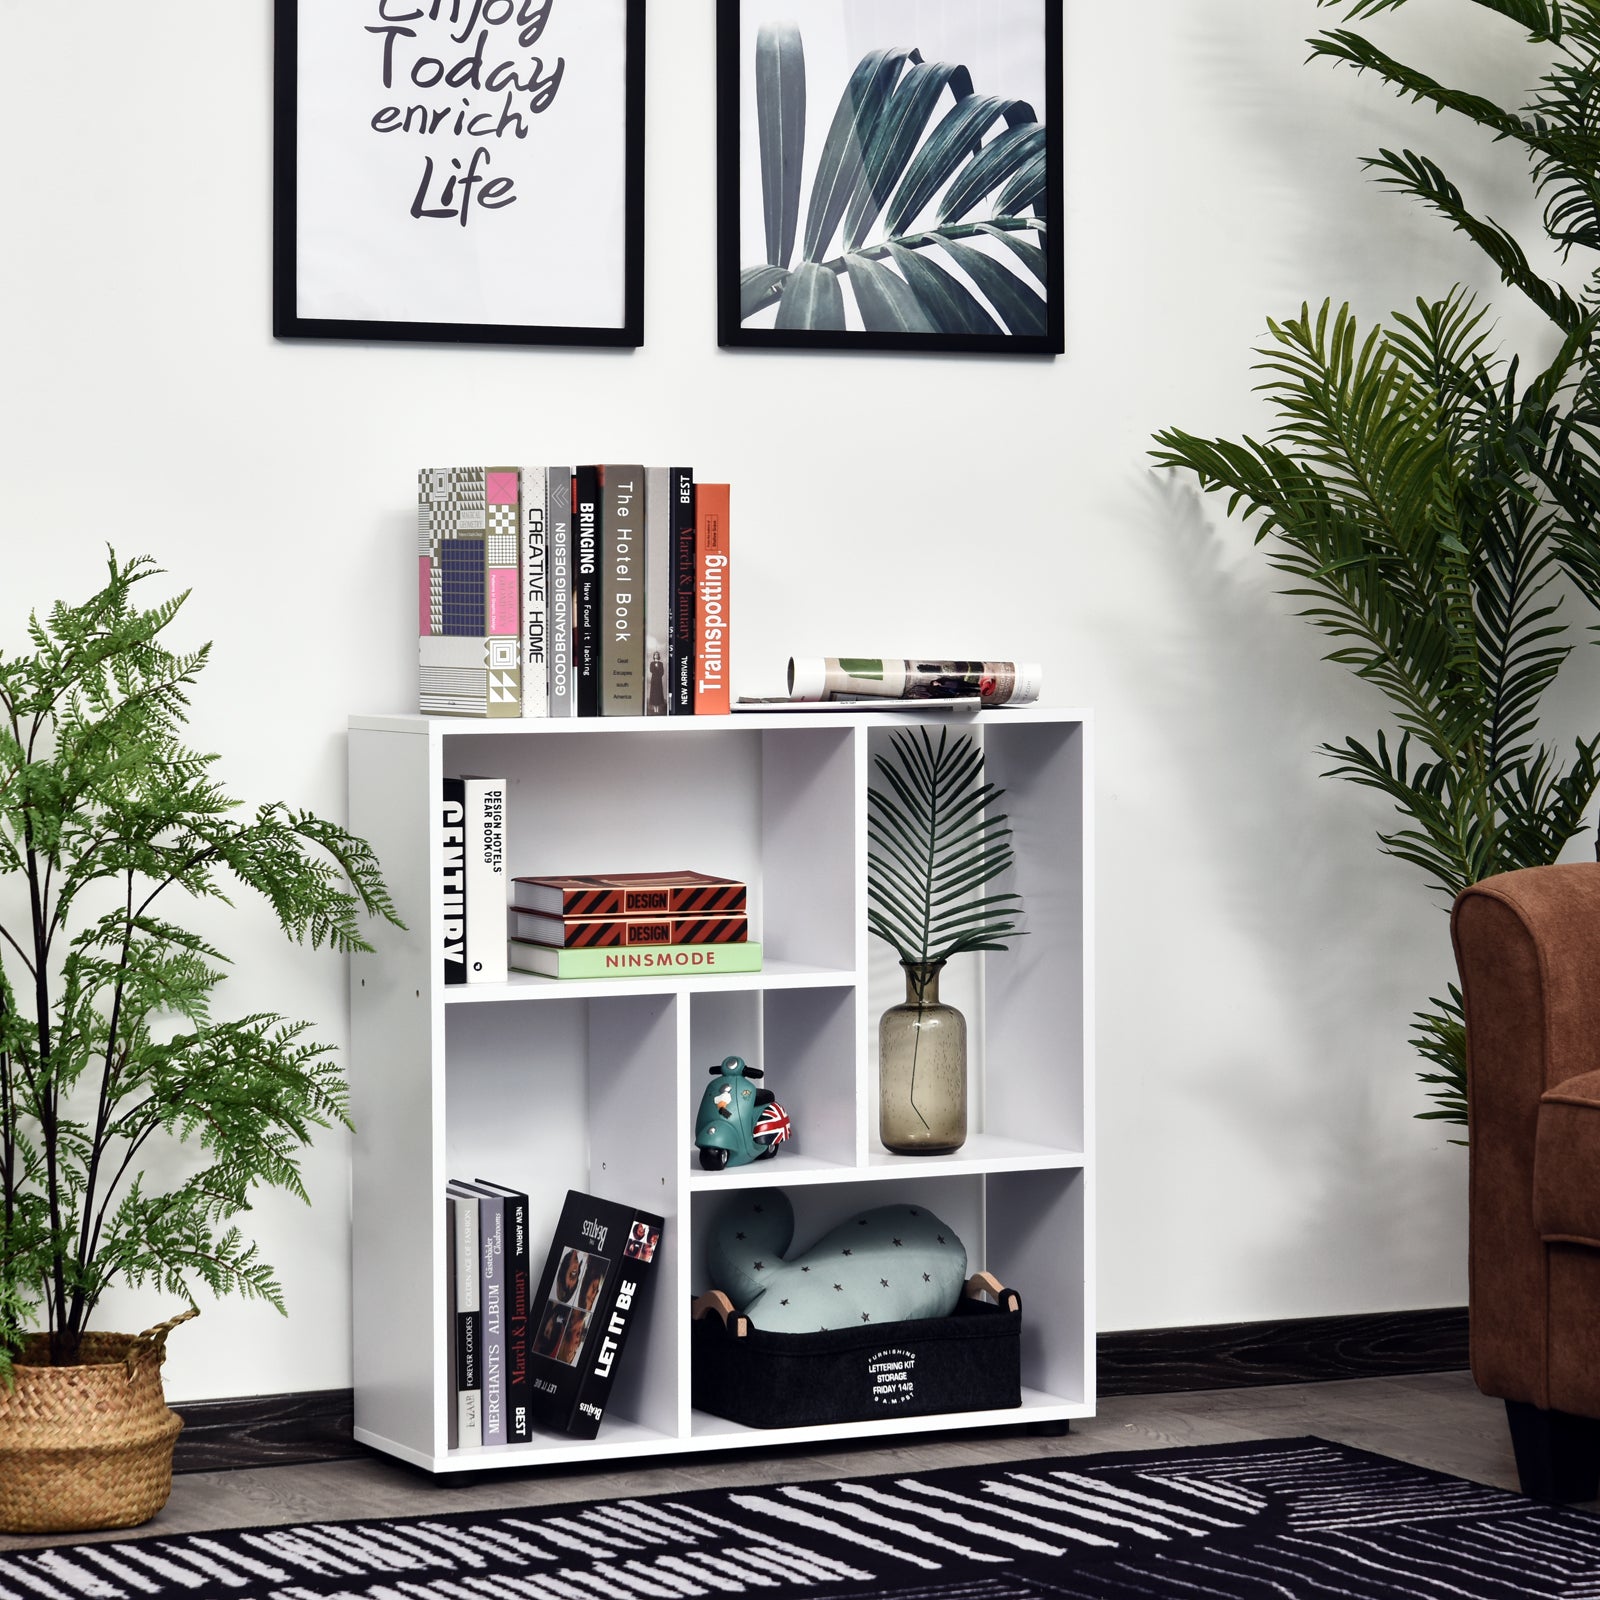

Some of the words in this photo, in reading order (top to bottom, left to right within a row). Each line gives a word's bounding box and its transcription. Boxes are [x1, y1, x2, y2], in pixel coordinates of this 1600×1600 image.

[364, 26, 565, 114] Today
[371, 91, 528, 139] enrich
[410, 147, 517, 227] Life
[617, 481, 633, 516] The
[680, 475, 690, 504] BEST
[529, 509, 543, 601] CREATIVE
[580, 503, 594, 574] BRINGING
[616, 529, 632, 581] Hotel
[680, 528, 692, 570] March
[680, 574, 692, 585] &
[616, 593, 632, 642] Book
[678, 589, 692, 640] January
[529, 612, 544, 663] HOME
[583, 646, 591, 676] lacking
[484, 791, 492, 818] YEAR
[493, 791, 502, 828] DESIGN
[493, 833, 502, 872] HOTELS
[627, 894, 667, 909] DESIGN
[629, 926, 669, 941] DESIGN
[606, 952, 715, 968] NINSMODE
[488, 1284, 500, 1334] ALBUM
[512, 1270, 527, 1322] January
[616, 1280, 636, 1310] BE
[512, 1325, 525, 1336] &
[608, 1312, 626, 1335] IT
[512, 1340, 525, 1384] March
[594, 1336, 618, 1378] LET
[868, 1362, 903, 1373] LETTERING
[904, 1360, 915, 1369] KIT
[488, 1344, 500, 1434] MERCHANTS
[546, 1384, 557, 1394] LET
[873, 1384, 896, 1395] FRIDAY
[898, 1382, 914, 1392] 14/2
[877, 1372, 907, 1383] STORAGE
[516, 1407, 526, 1436] BEST
